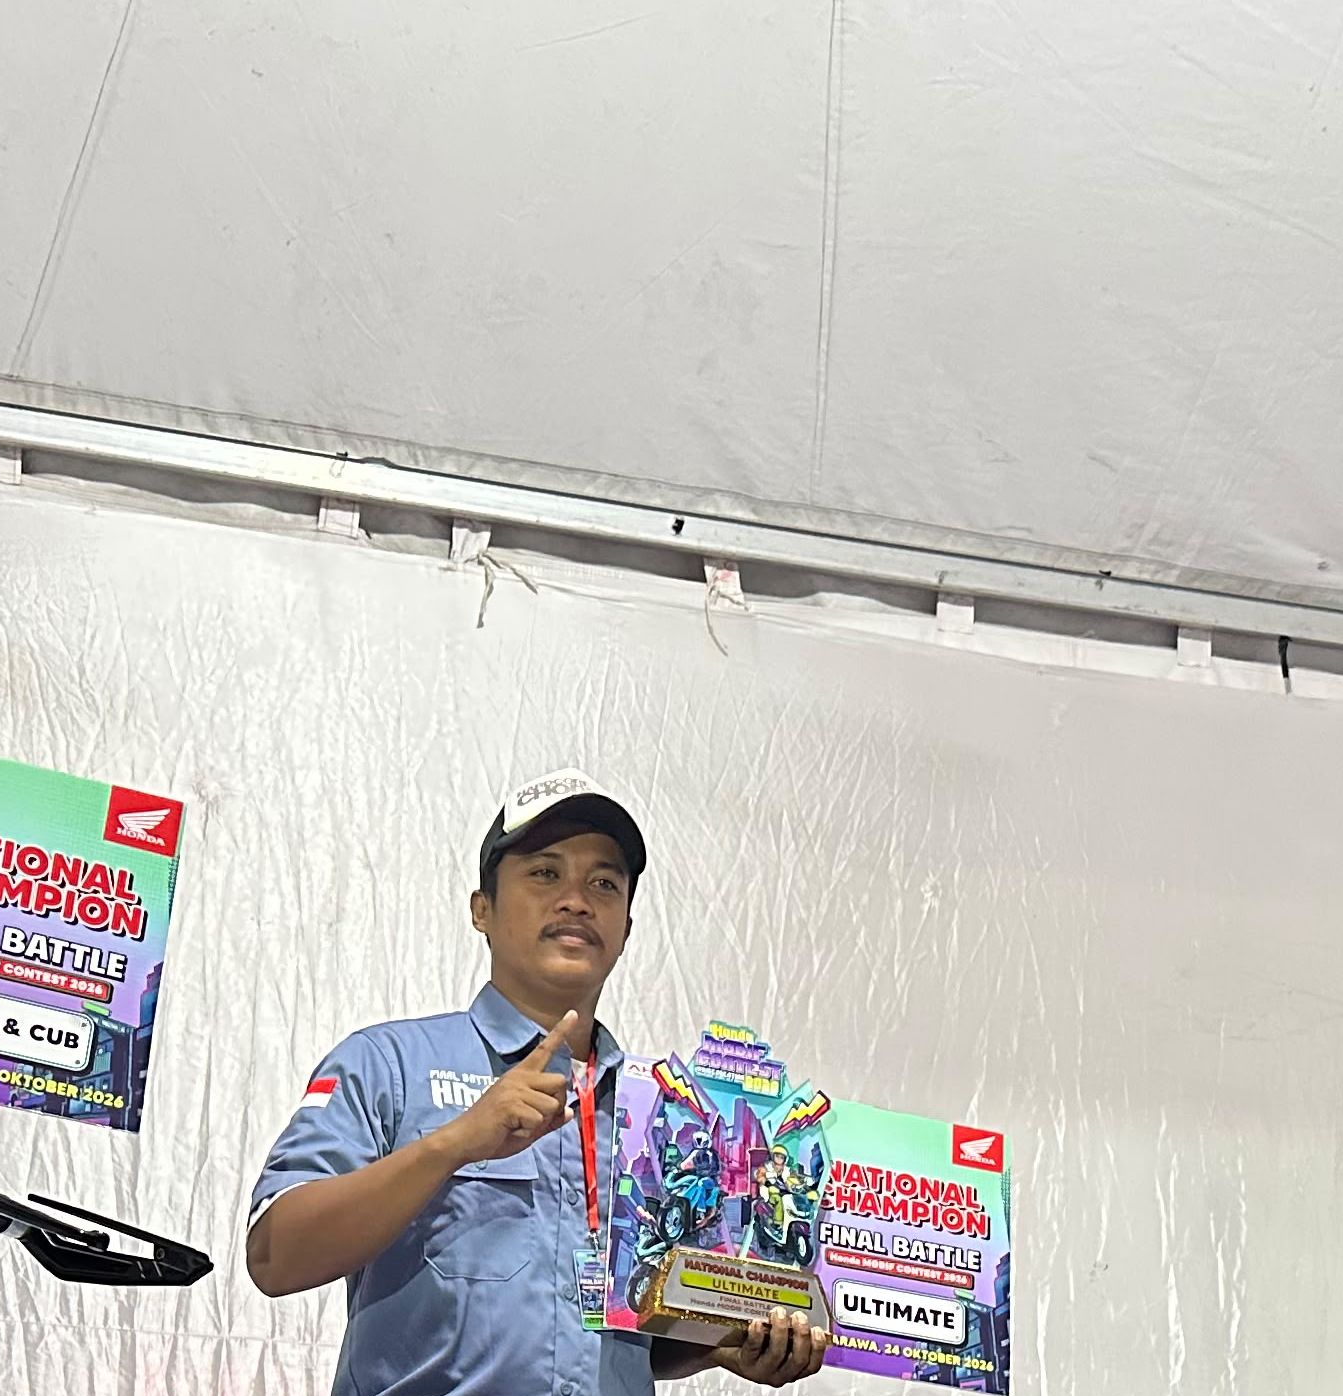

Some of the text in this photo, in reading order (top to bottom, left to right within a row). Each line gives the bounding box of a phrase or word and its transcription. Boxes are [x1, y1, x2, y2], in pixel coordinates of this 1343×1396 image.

[116, 828, 167, 848] HONDA
[1, 926, 127, 982] BATTLE
[2, 959, 68, 987] CONTEST
[69, 977, 104, 997] 2026
[3, 1017, 20, 1038] &
[30, 1023, 80, 1050] CUB
[81, 1086, 125, 1110] 2026
[959, 1154, 996, 1166] HONDA
[819, 1222, 982, 1272] FINAL BATTLE
[684, 1258, 809, 1292] NATIONAL CHAMPION
[896, 1264, 942, 1280] CONTEST
[712, 1278, 780, 1300] ULTIMATE
[843, 1292, 955, 1330] ULTIMATE
[884, 1343, 900, 1356] 24
[902, 1347, 962, 1368] OKTOBER
[964, 1355, 995, 1372] 2026
